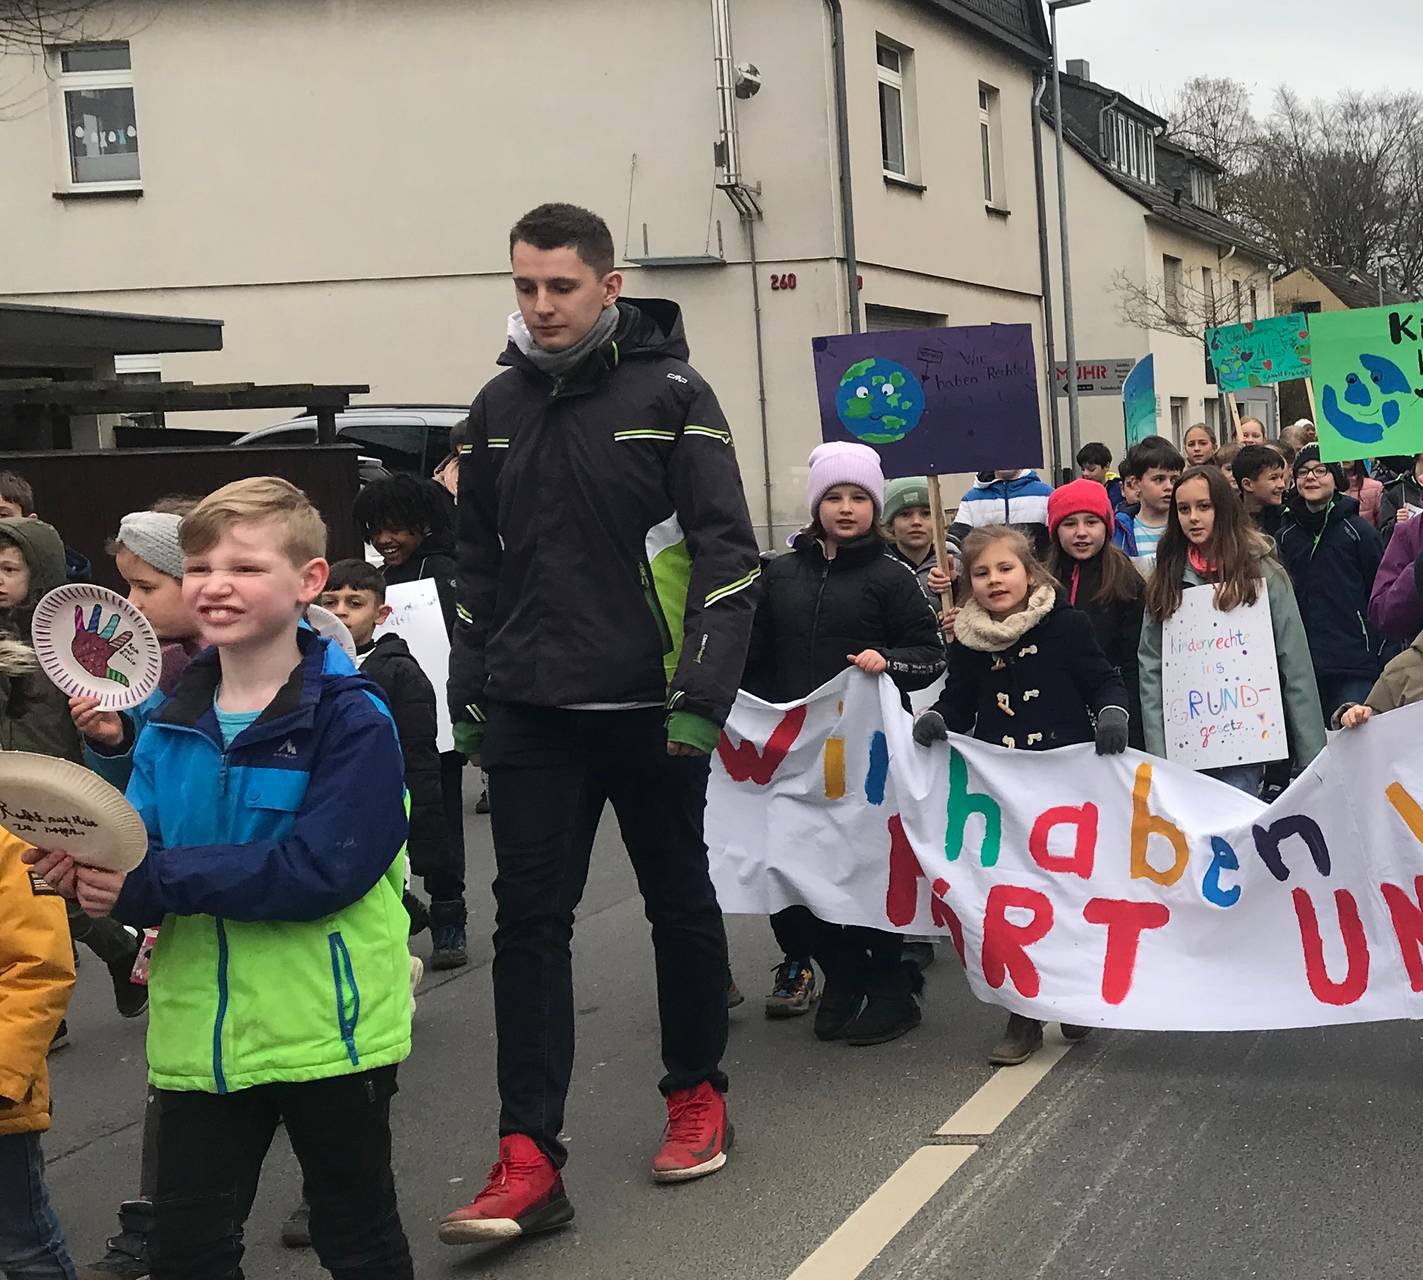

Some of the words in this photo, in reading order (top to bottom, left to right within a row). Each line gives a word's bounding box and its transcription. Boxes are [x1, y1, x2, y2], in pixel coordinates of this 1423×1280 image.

[770, 272, 796, 290] 260
[935, 374, 978, 391] haben
[1202, 661, 1225, 674] ins
[1170, 685, 1271, 726] GRUND-
[944, 745, 1331, 909] haben
